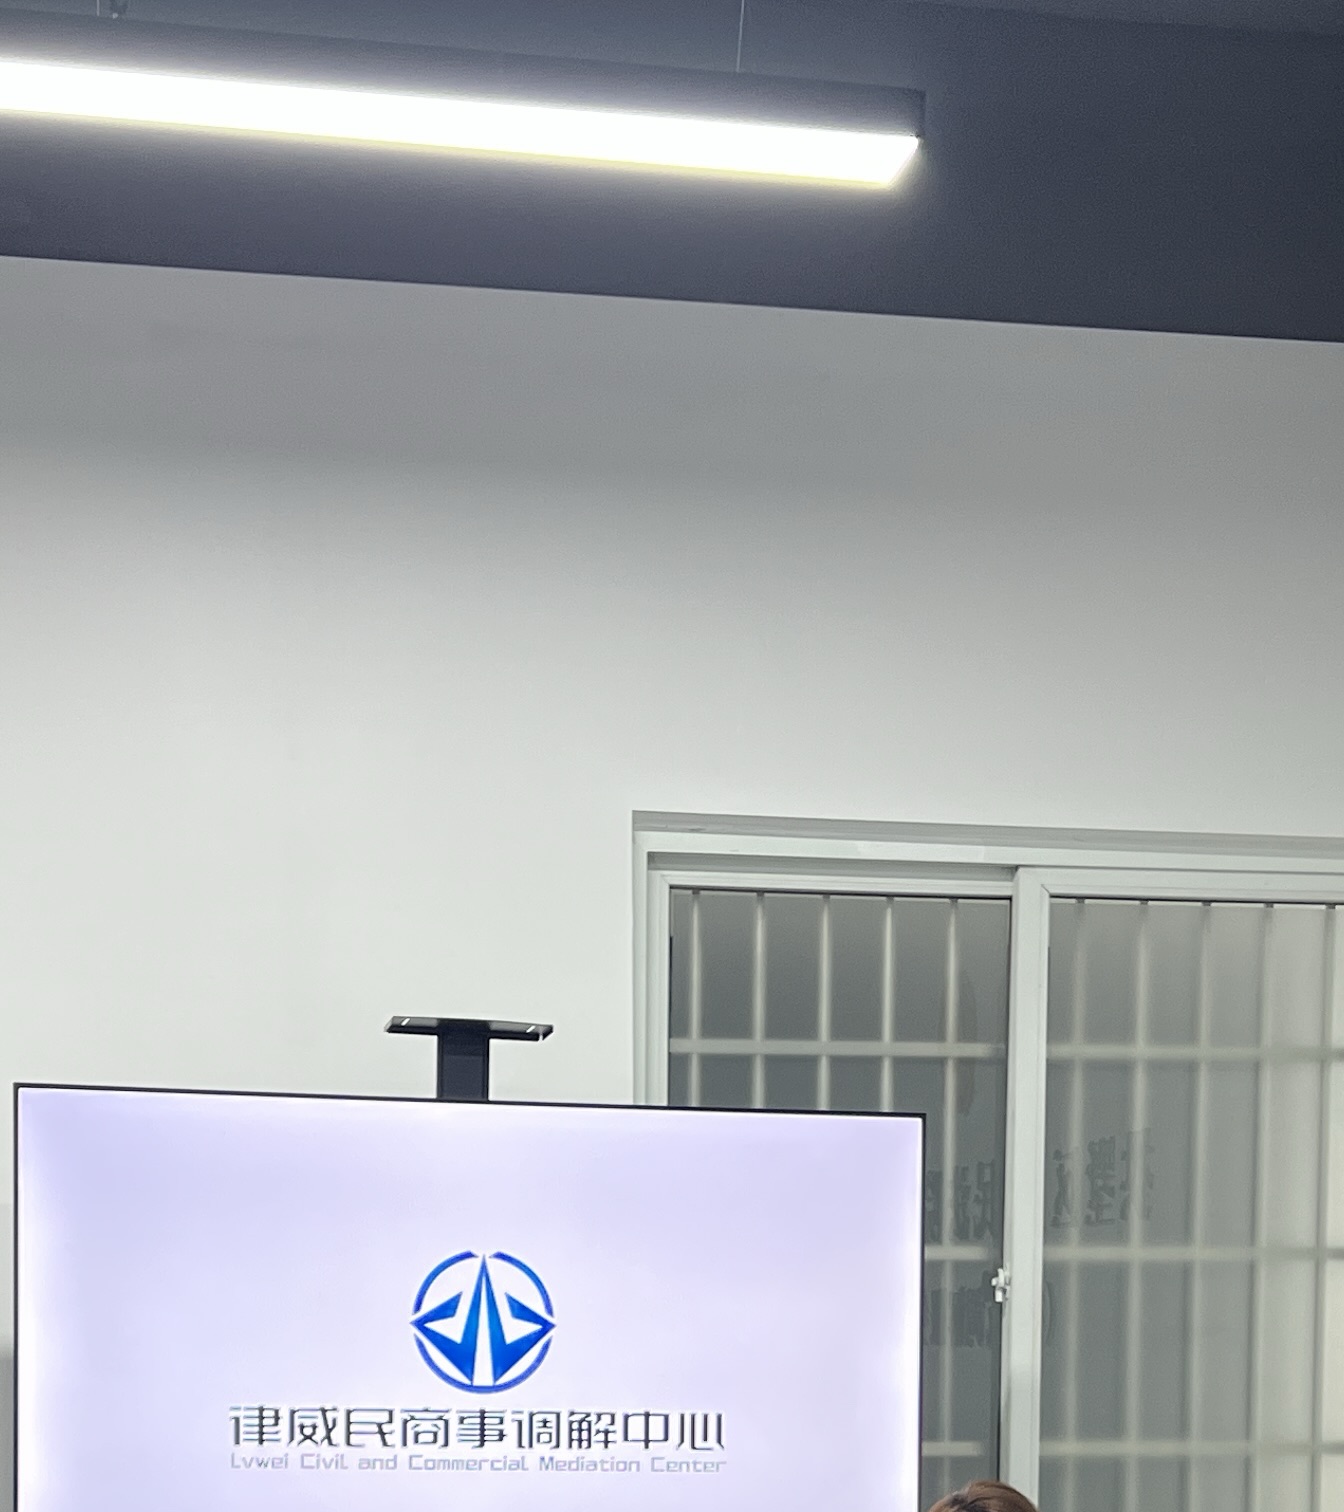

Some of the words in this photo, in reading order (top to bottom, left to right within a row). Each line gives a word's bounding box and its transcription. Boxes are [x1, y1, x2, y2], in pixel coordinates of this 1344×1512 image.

[229, 1405, 725, 1451] 律威民商事调解中心
[299, 1452, 349, 1470] Civil
[358, 1454, 398, 1470] and
[408, 1454, 529, 1472] Commercial
[538, 1455, 641, 1472] Mediation
[650, 1456, 727, 1473] Center
